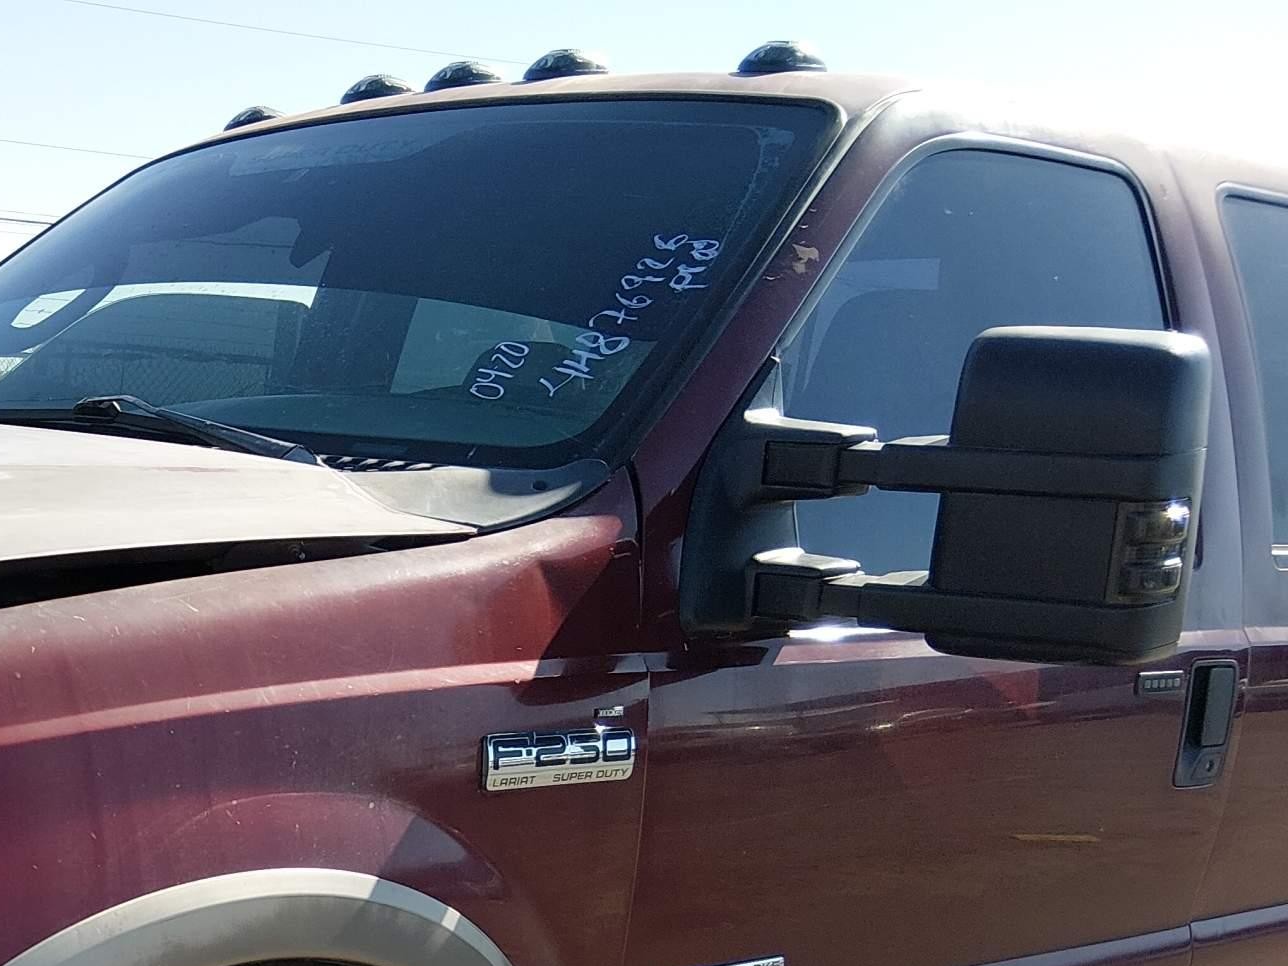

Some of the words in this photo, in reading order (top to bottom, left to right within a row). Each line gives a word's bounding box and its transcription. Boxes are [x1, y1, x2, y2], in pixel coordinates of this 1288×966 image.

[492, 776, 536, 788] LARIAT
[552, 771, 593, 783] SUPER
[595, 768, 629, 779] DUTY
